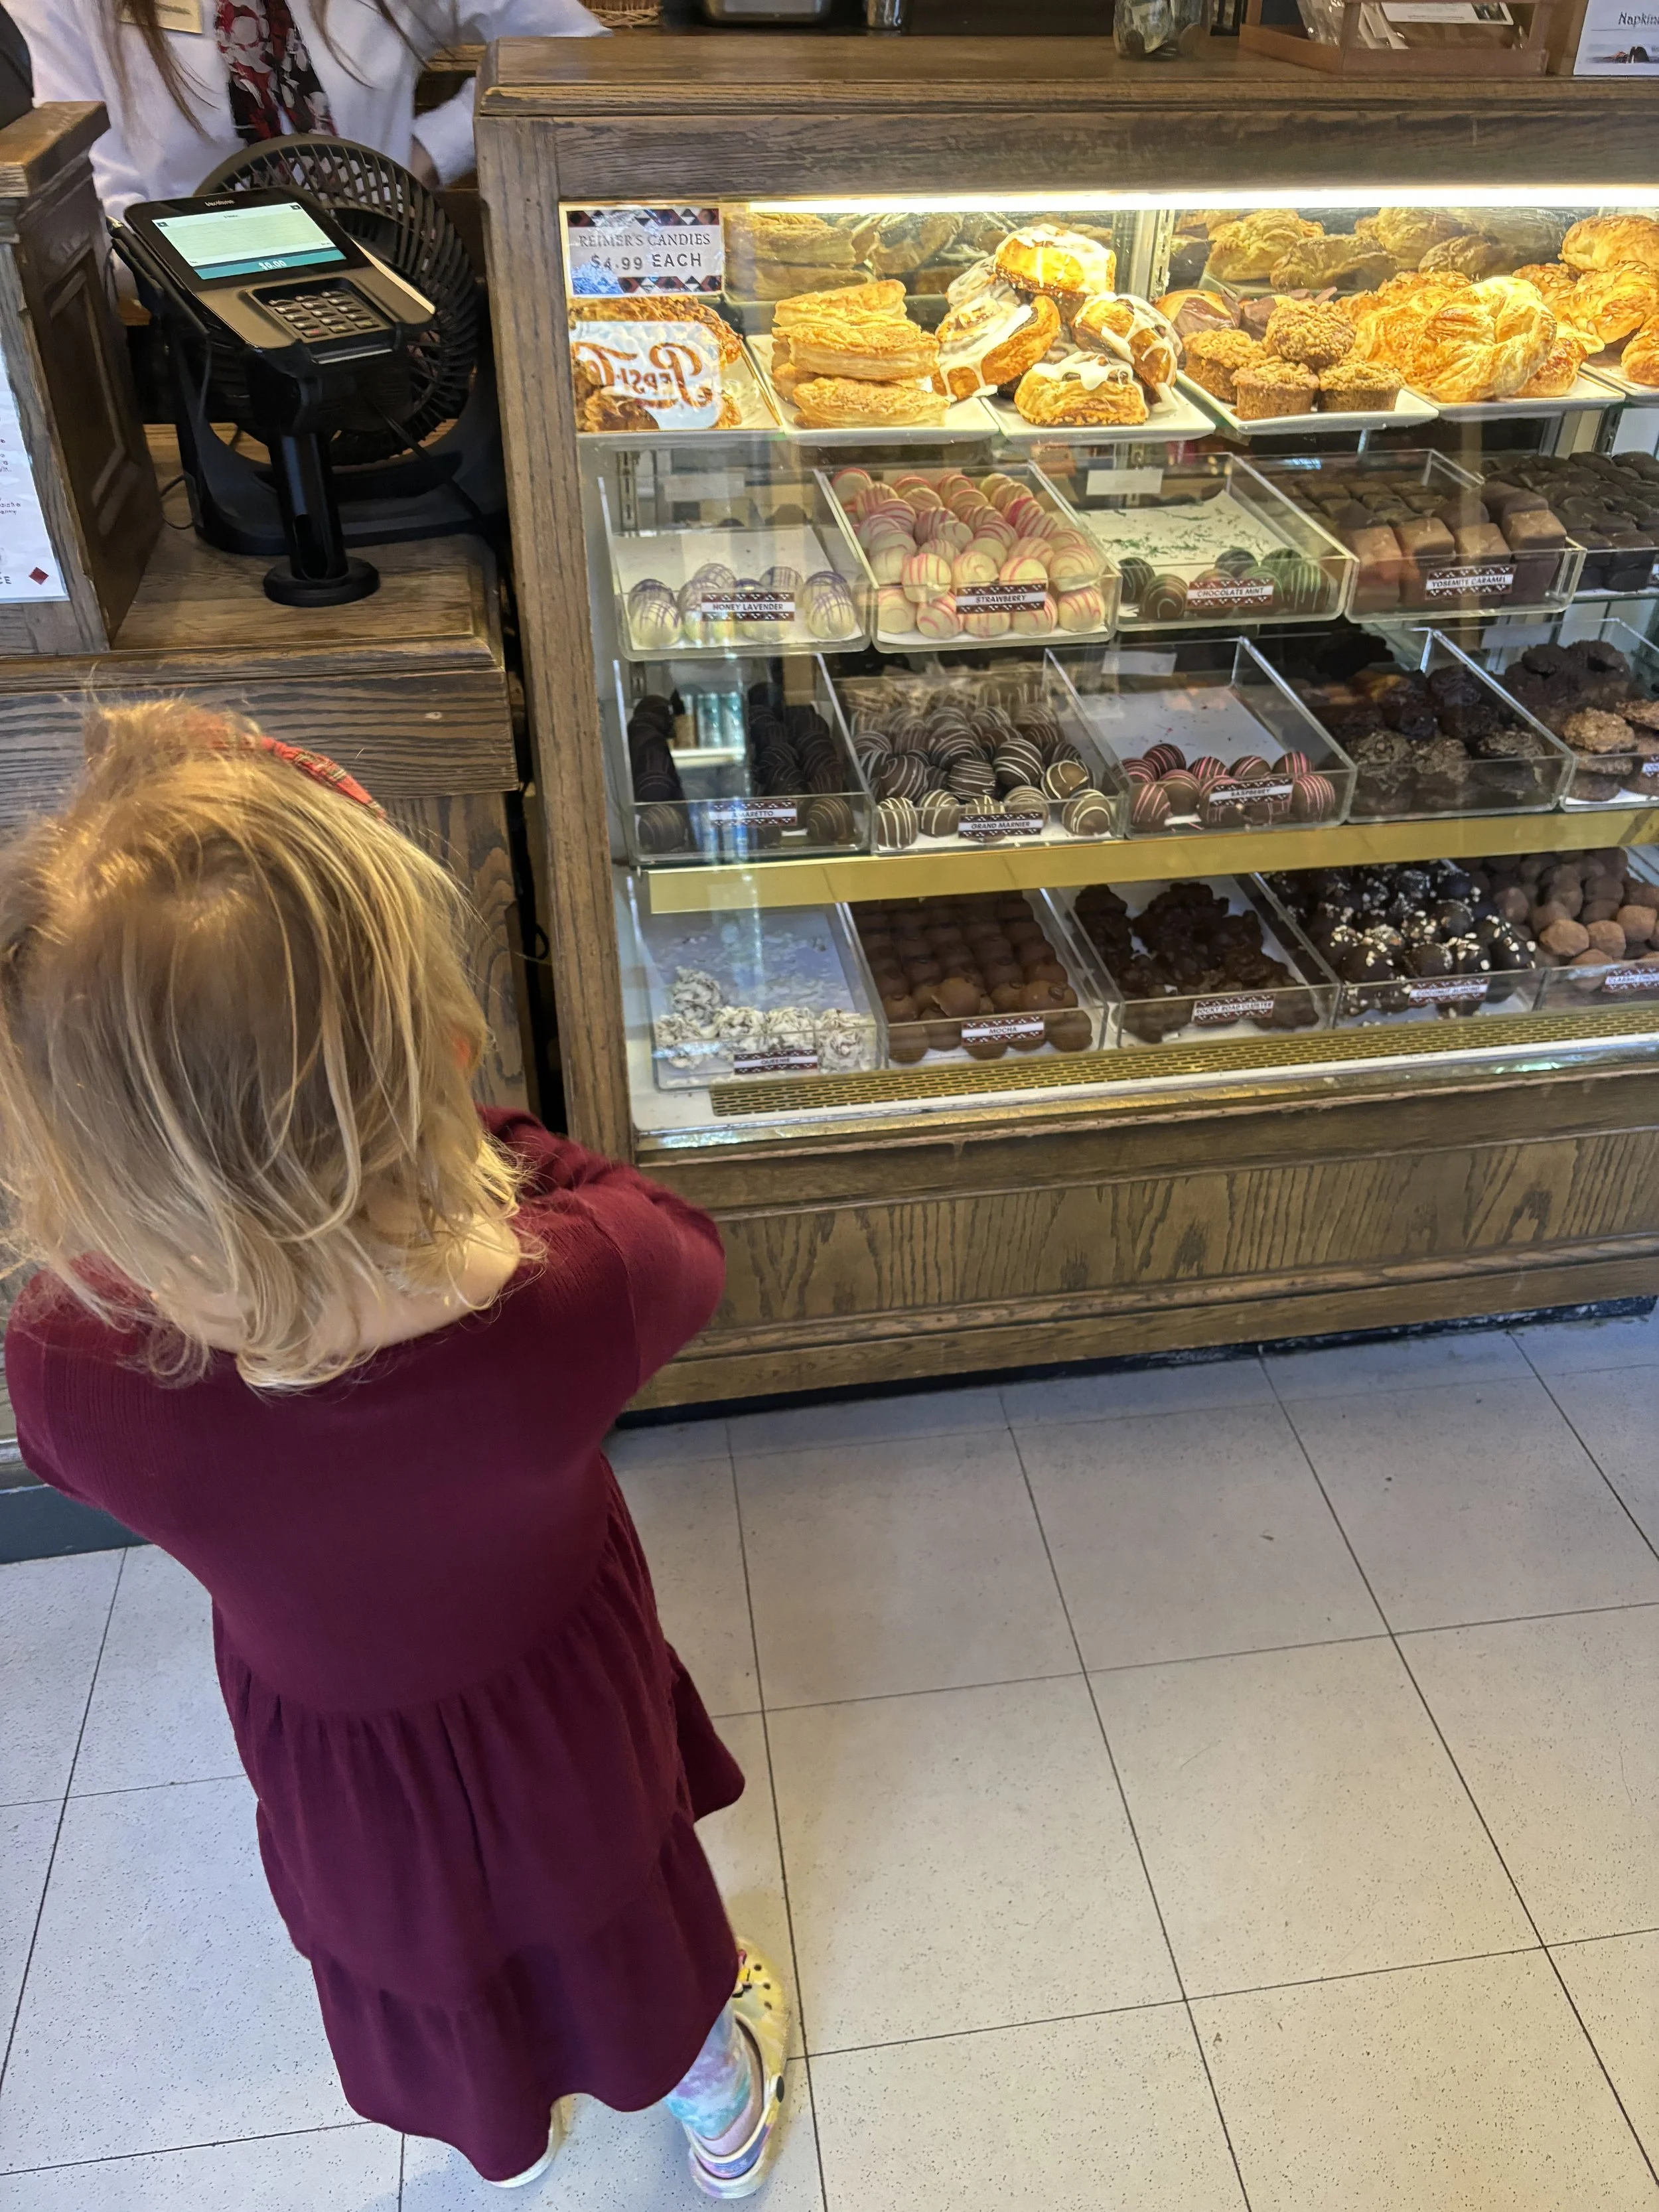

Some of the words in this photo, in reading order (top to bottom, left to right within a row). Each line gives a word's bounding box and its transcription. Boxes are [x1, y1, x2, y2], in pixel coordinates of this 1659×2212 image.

[648, 233, 711, 246] CANDIES
[652, 252, 701, 267] EACH
[1196, 589, 1243, 597] CHOCOLATE
[975, 595, 1027, 603] STRAWBERRY
